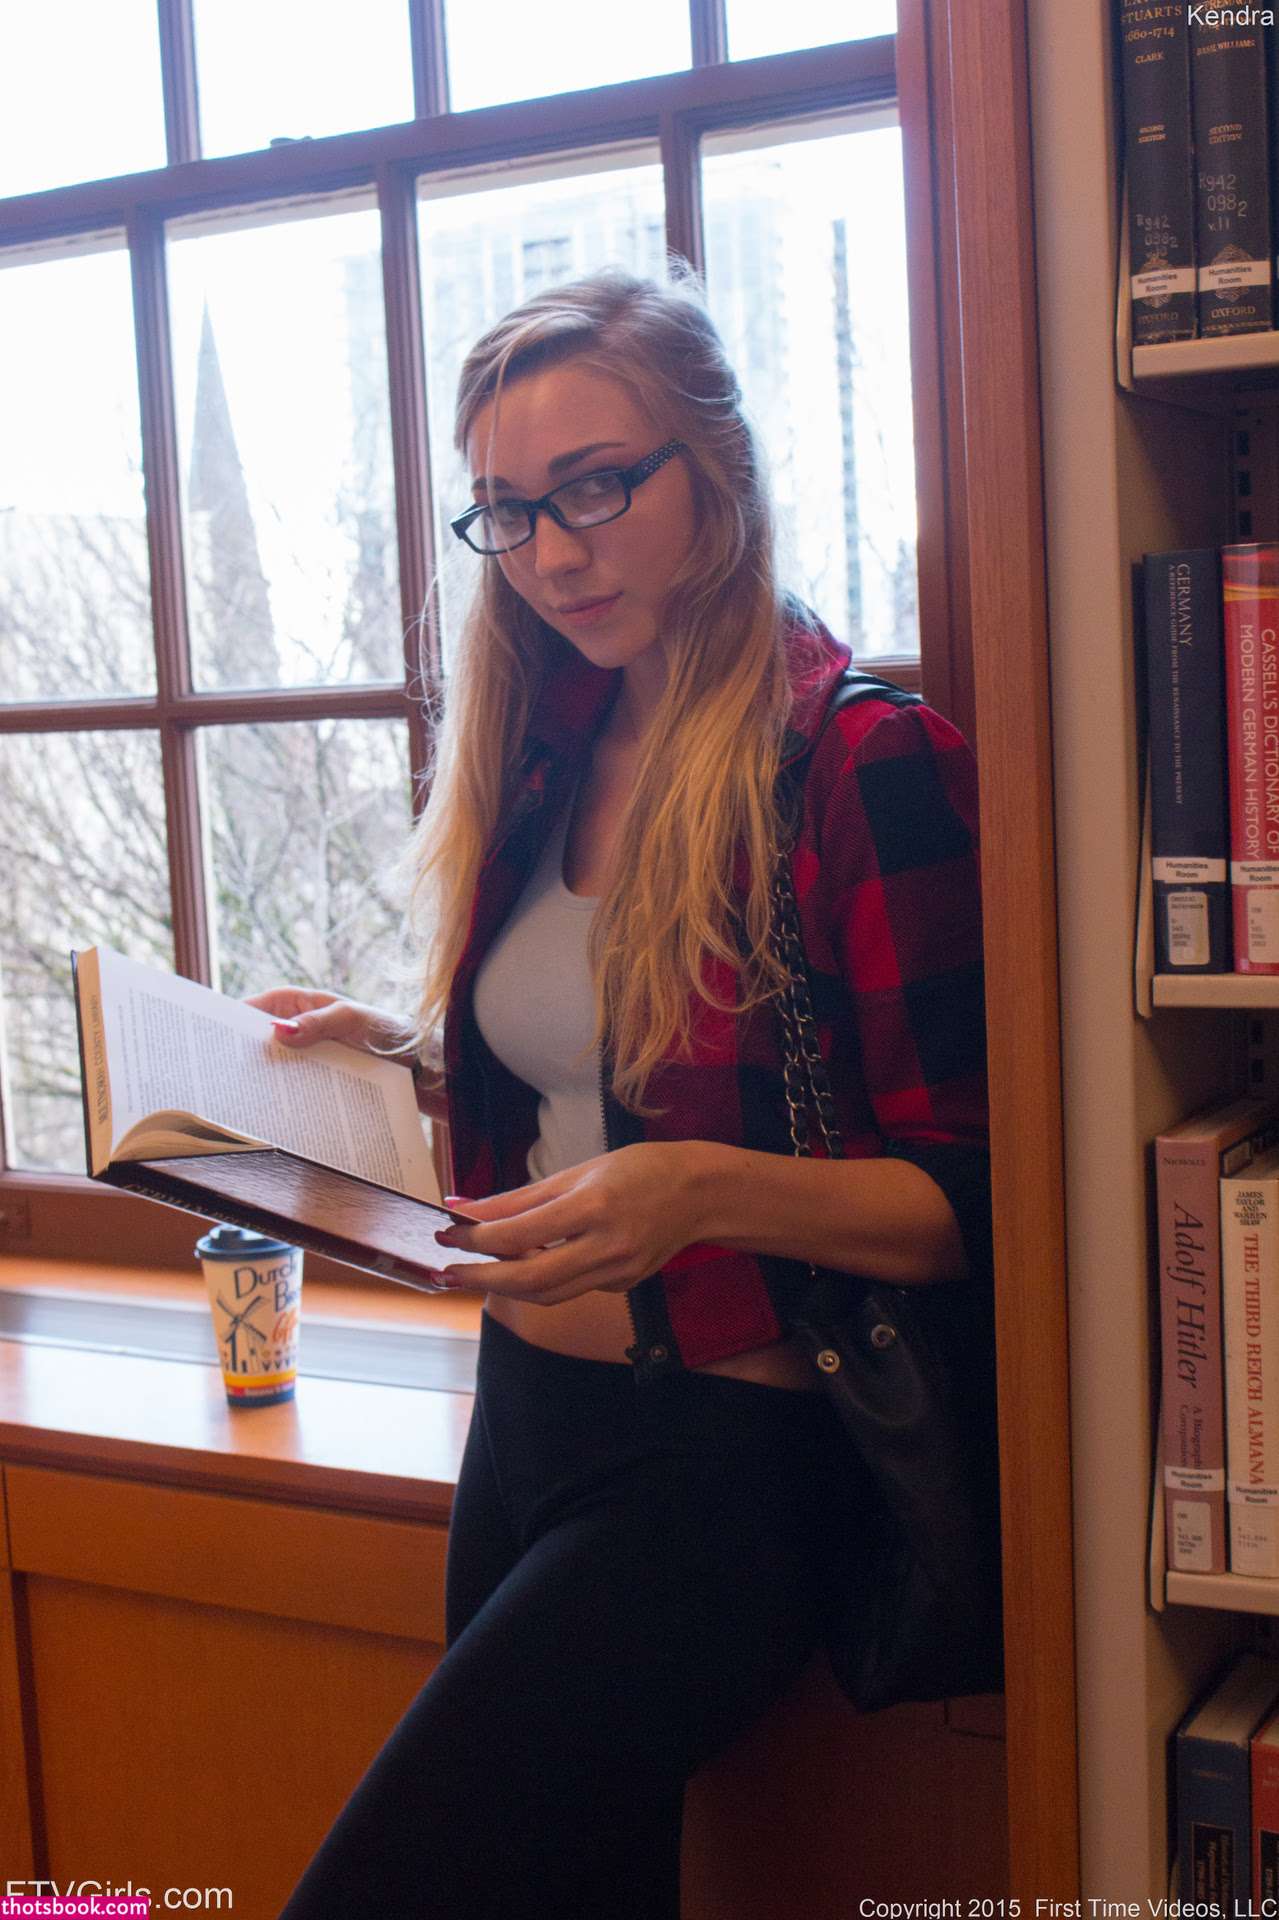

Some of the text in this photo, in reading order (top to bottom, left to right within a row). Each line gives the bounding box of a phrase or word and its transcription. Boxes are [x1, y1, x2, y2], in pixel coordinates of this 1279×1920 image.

[1135, 51, 1165, 64] CLARK
[1208, 266, 1253, 276] Humanities
[1218, 277, 1242, 285] Room
[1211, 306, 1256, 318] OXFORD
[1176, 563, 1192, 647] GERMANY
[1240, 624, 1260, 859] MODERN GERMAN HISTORY
[1261, 628, 1279, 853] CASSELL'S DICTIONARY OF
[1240, 865, 1279, 873] Humanitie
[1167, 1201, 1207, 1389] Adolf Hitler
[1244, 1233, 1265, 1485] THE THIRD REICH ALMANA
